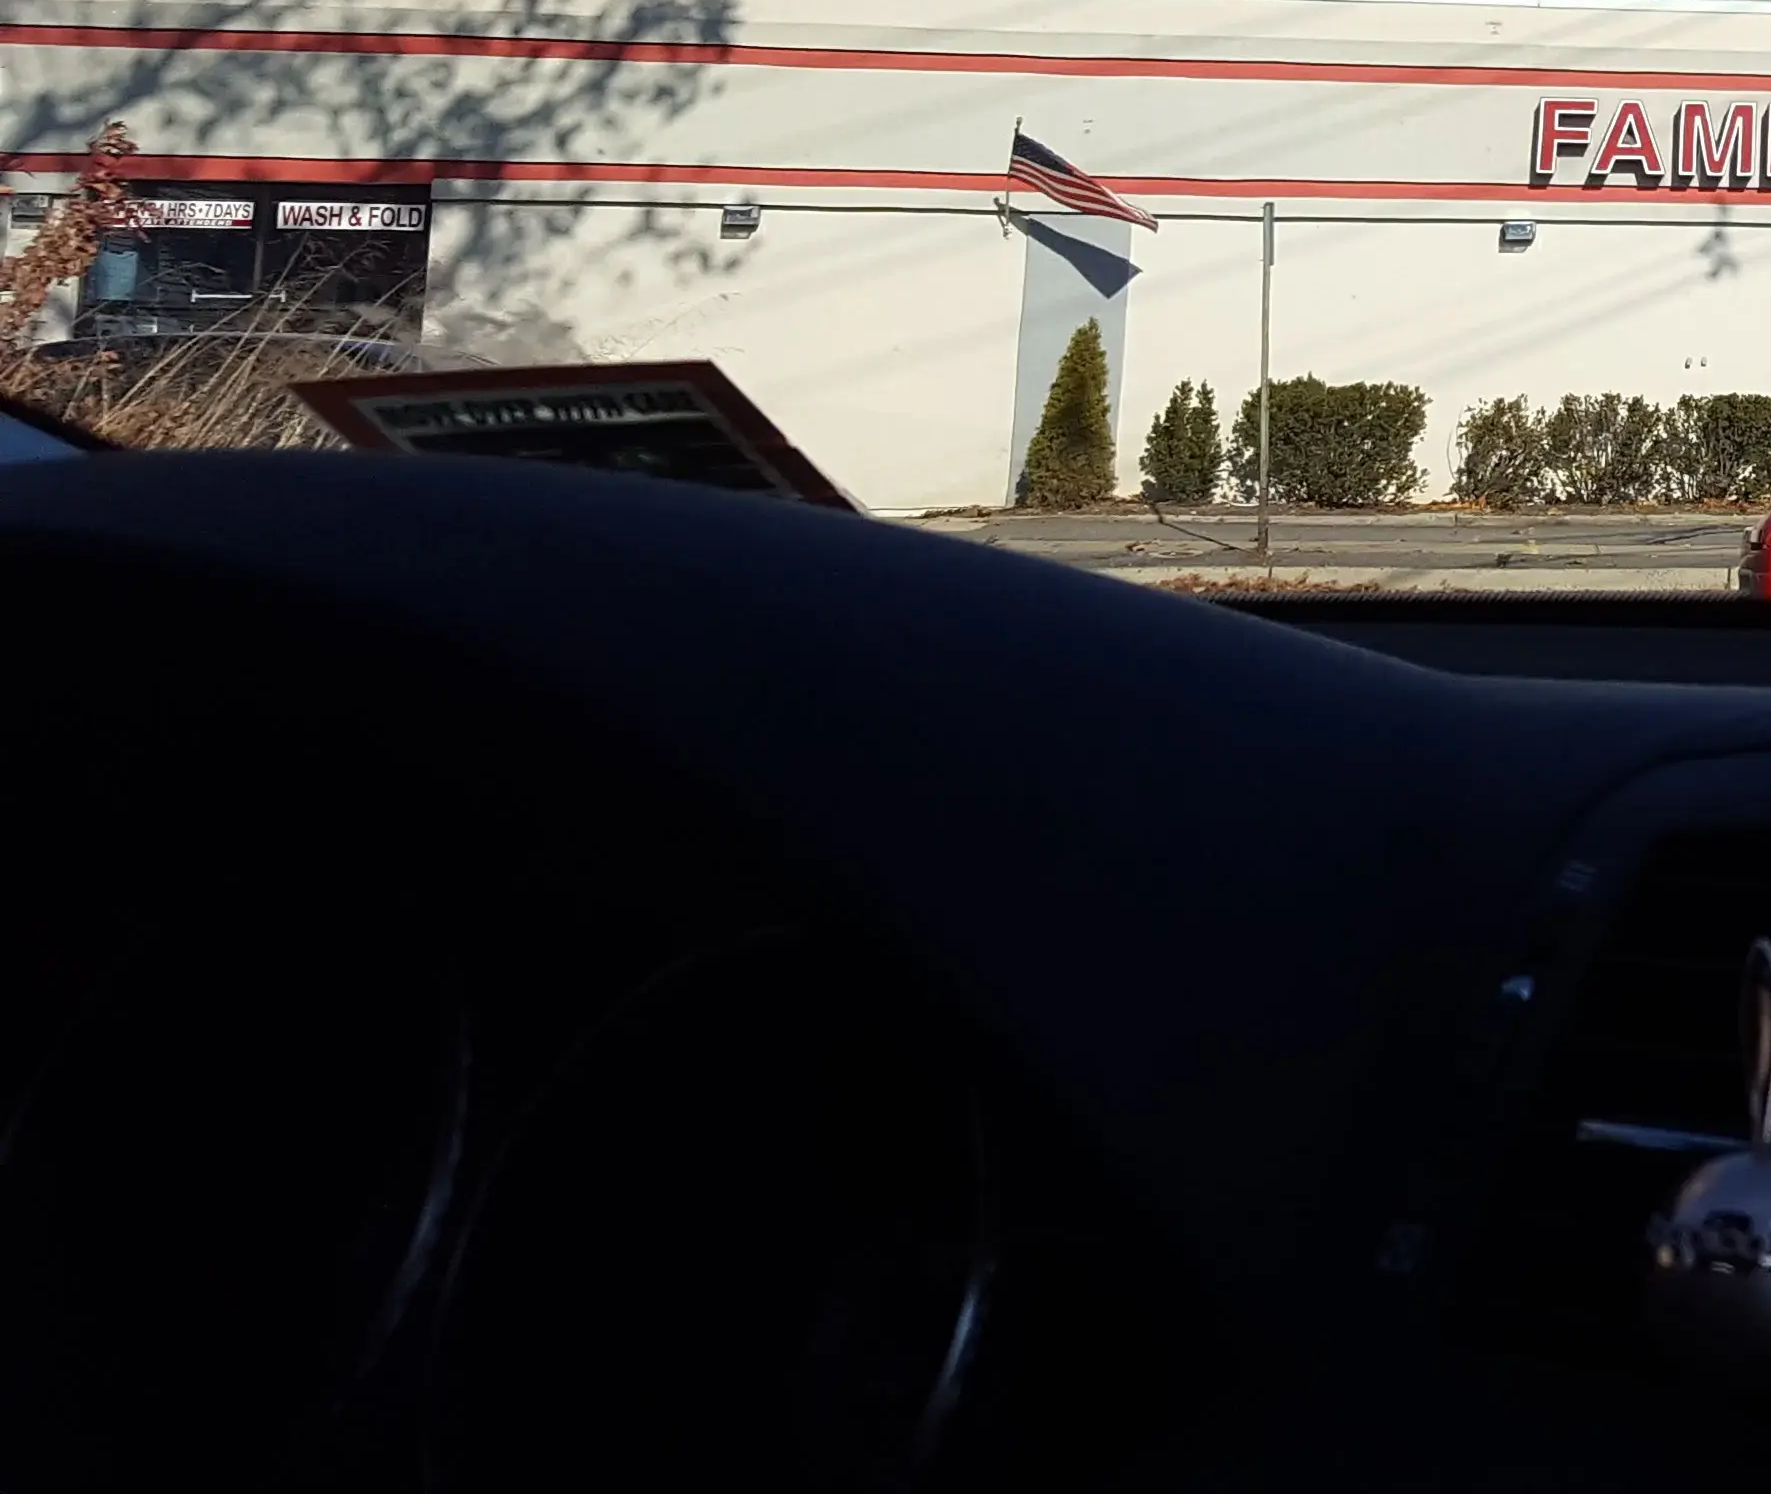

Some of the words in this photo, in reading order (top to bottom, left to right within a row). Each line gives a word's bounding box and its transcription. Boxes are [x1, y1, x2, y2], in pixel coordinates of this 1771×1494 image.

[167, 203, 197, 218] HRS
[205, 203, 213, 218] 7
[213, 203, 251, 219] DAYS
[282, 205, 344, 226] WASH
[348, 205, 363, 227] &
[368, 206, 422, 228] FOLD
